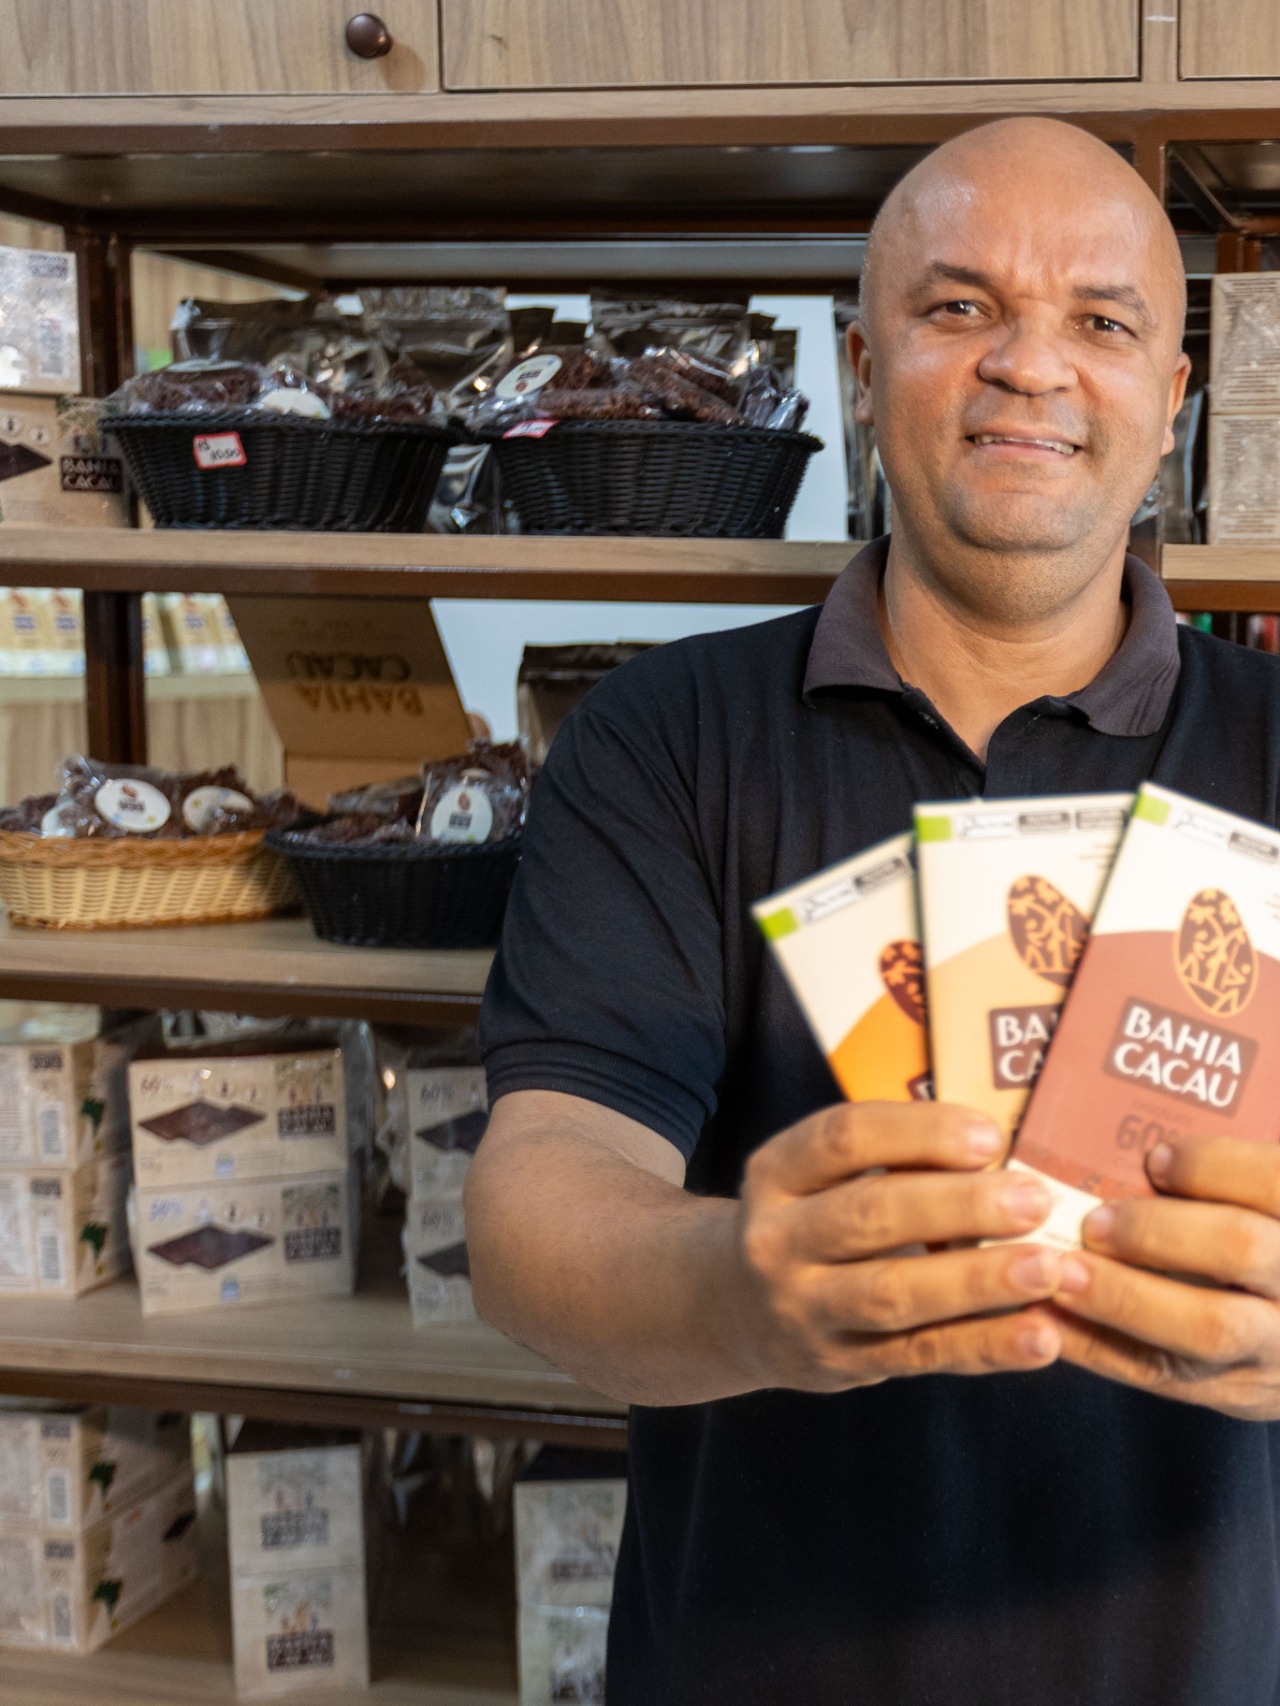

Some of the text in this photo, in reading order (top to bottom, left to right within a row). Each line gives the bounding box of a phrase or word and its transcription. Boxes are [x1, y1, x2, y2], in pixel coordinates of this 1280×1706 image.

[1124, 1005, 1242, 1076] BAHIA
[1113, 1042, 1239, 1108] CACAU
[1116, 1113, 1182, 1153] 60
